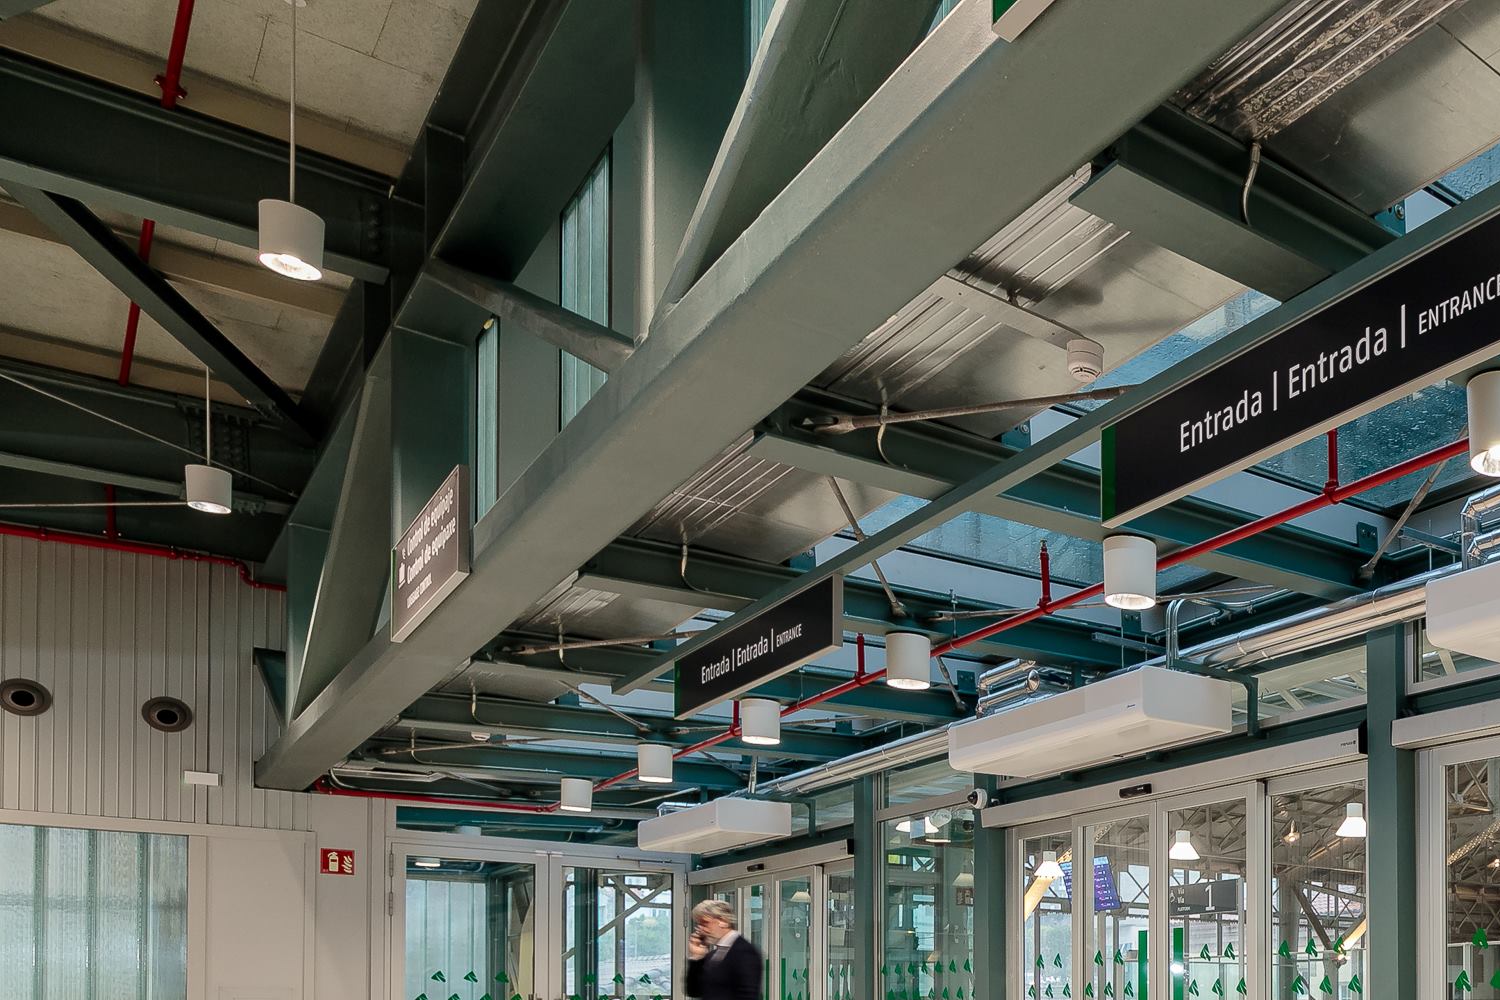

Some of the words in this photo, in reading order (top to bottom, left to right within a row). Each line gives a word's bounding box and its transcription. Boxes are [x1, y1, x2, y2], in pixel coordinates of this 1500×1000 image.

[1180, 390, 1262, 453] Entrada
[1288, 326, 1388, 400] Entrada
[423, 514, 431, 537] de
[424, 543, 432, 565] de
[701, 655, 730, 684] Entrada
[737, 635, 768, 667] Entrada
[776, 623, 802, 647] ENTRANCE
[1205, 884, 1216, 911] 1
